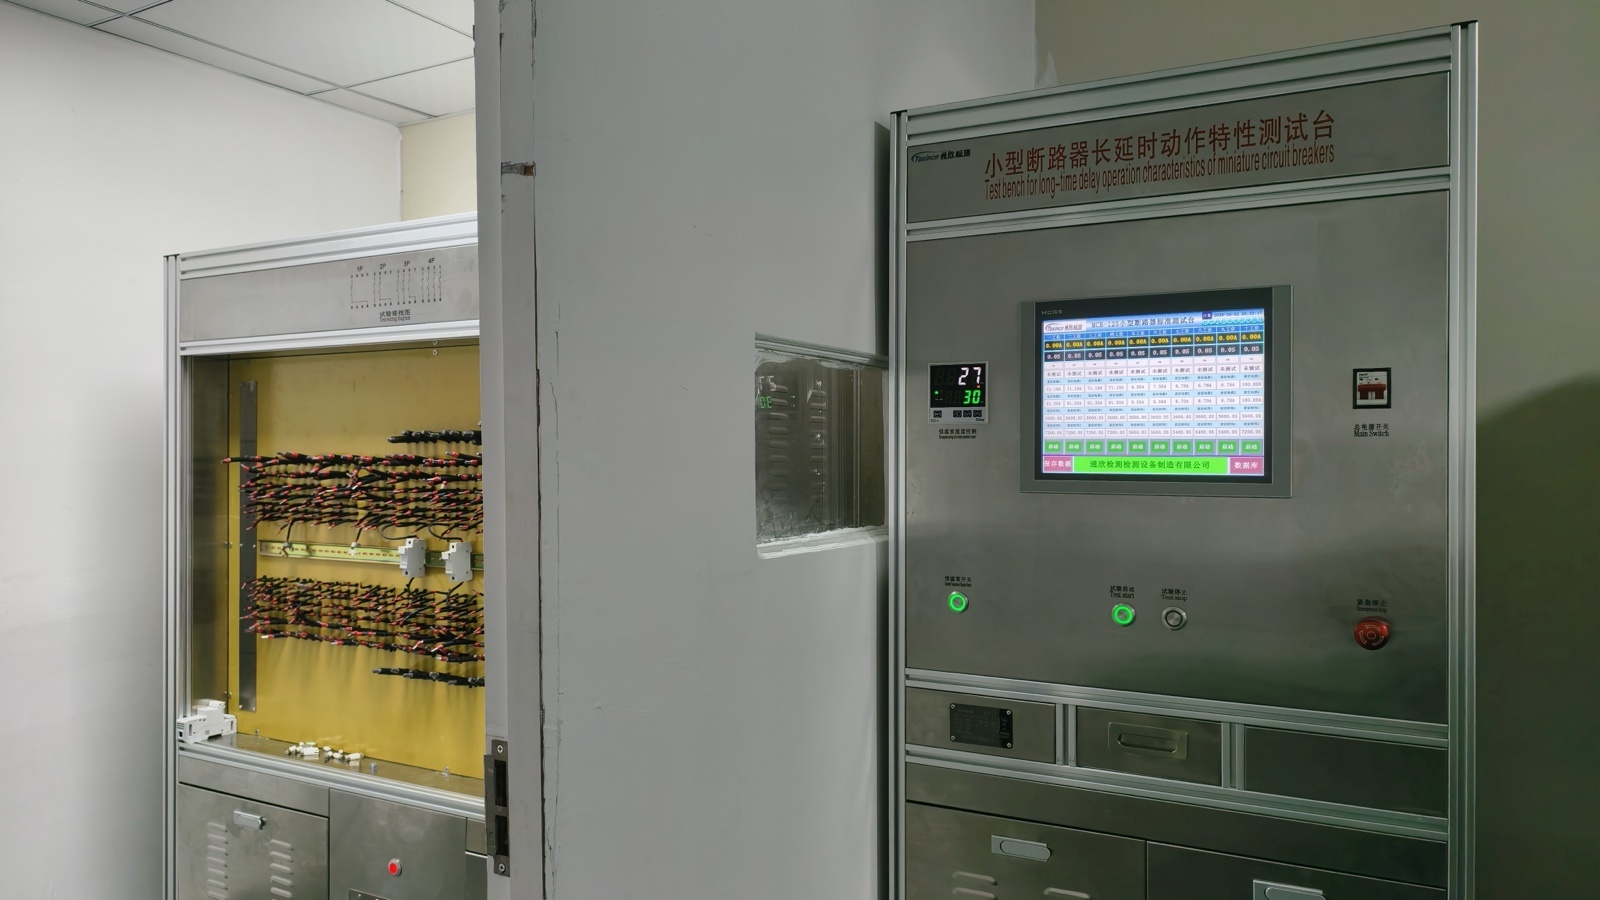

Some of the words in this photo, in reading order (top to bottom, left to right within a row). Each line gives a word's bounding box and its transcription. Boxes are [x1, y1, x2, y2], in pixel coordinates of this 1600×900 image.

[985, 110, 1334, 178] 小型断路器长延时动作特性测试台
[985, 179, 1001, 200] Test
[1003, 175, 1025, 198] bench
[1027, 174, 1037, 195] for
[1039, 171, 1077, 199] long-time
[1079, 167, 1100, 194] delay
[1103, 163, 1141, 192] operation
[1143, 155, 1205, 183] characteristics
[1208, 152, 1216, 176] of
[1218, 150, 1260, 174] miniature
[1262, 145, 1290, 170] circuit
[1293, 141, 1335, 167] breakers
[958, 367, 982, 385] 27
[963, 390, 981, 404] 30
[1090, 460, 1210, 469] 通欣检测检测设备制造有限公司
